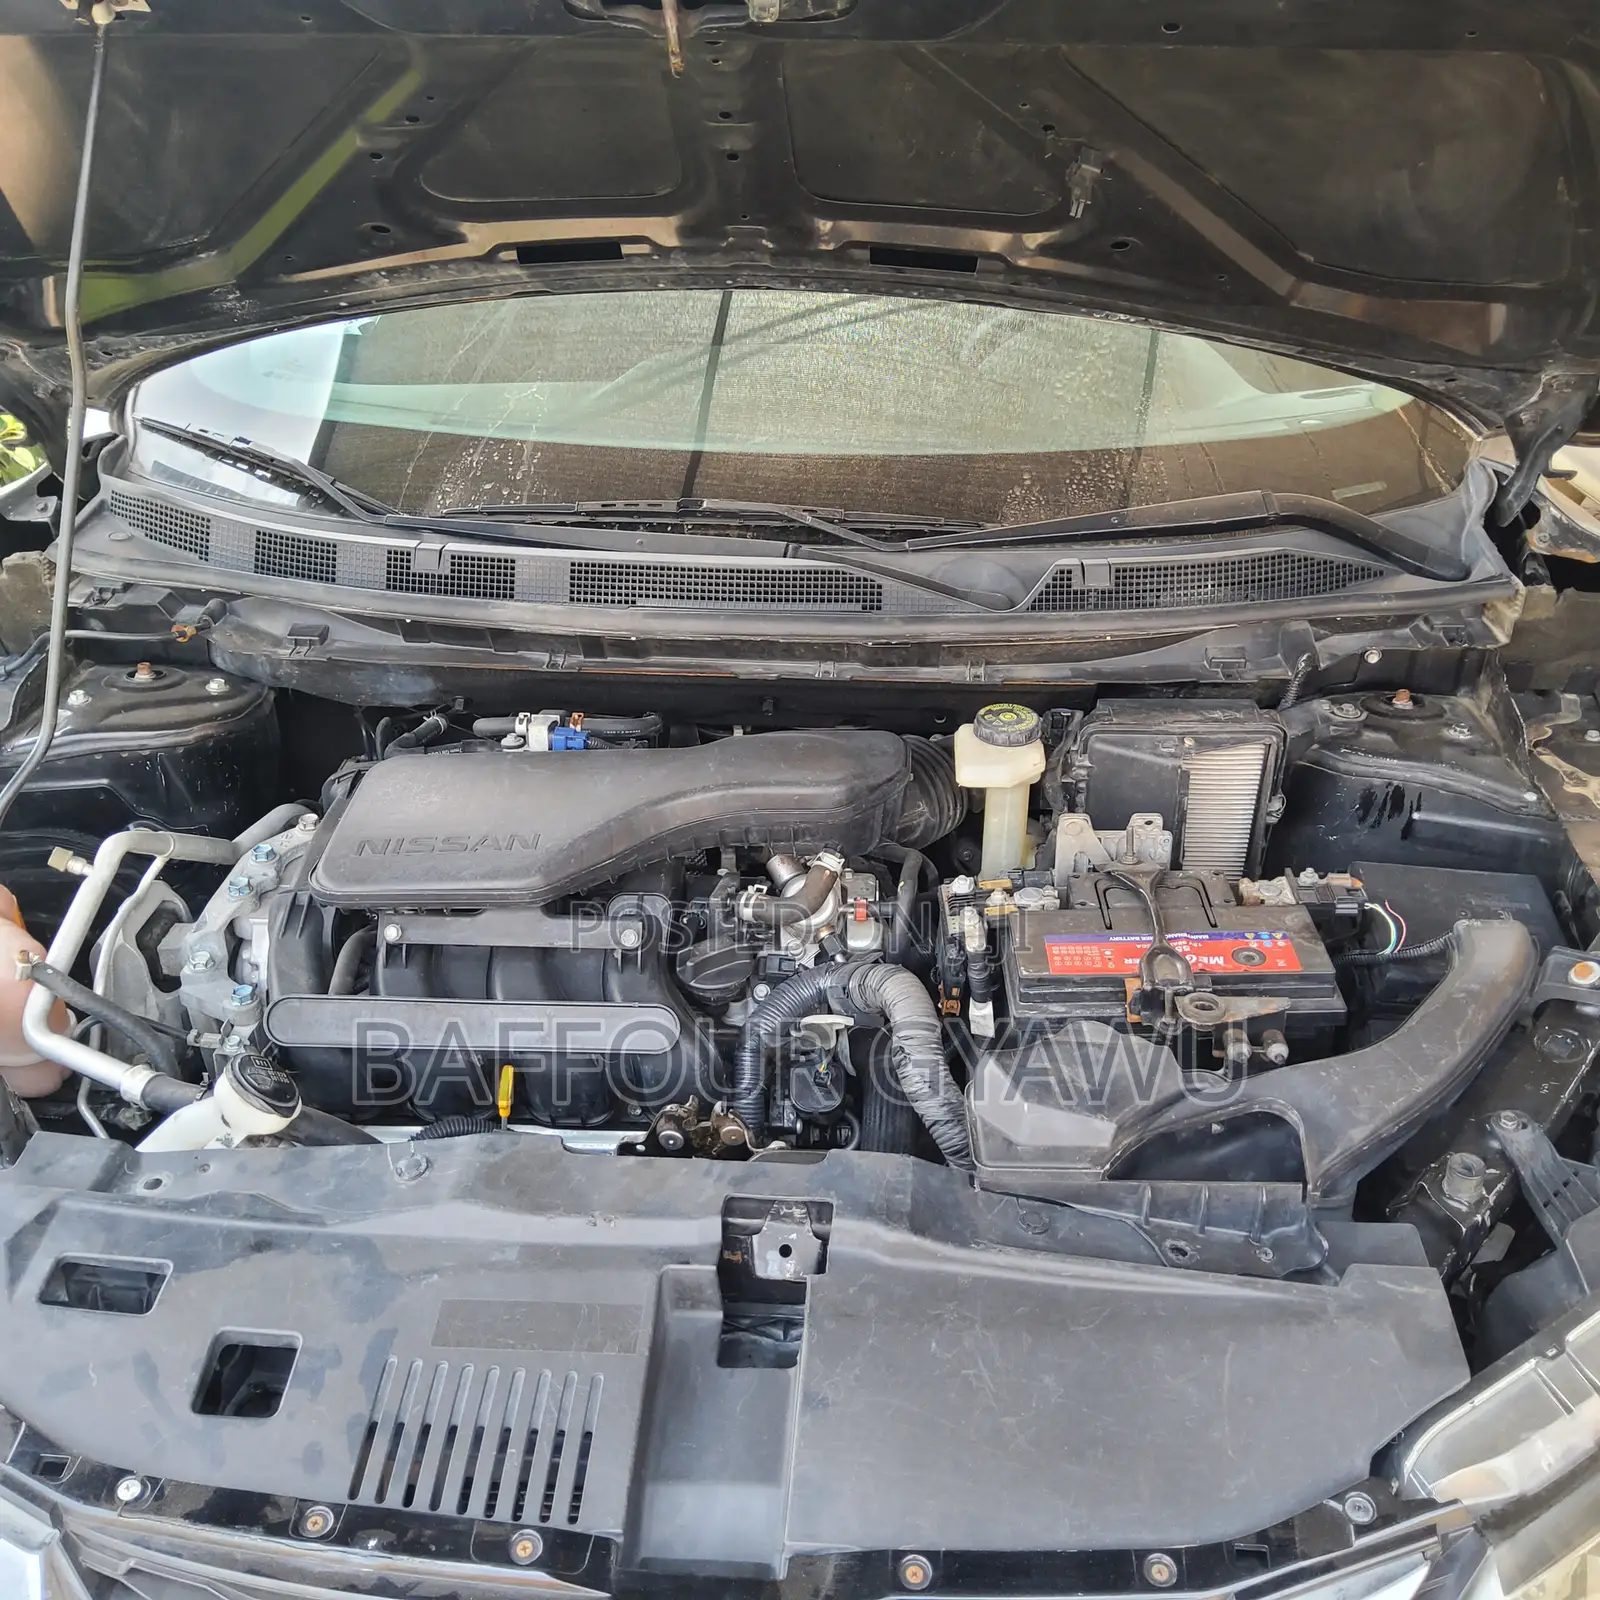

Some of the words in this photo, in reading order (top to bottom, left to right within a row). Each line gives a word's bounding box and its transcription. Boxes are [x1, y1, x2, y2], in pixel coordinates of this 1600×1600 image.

[352, 833, 541, 857] NISSAN
[1164, 932, 1209, 940] MAINTENANC
[1185, 954, 1225, 965] MEG
